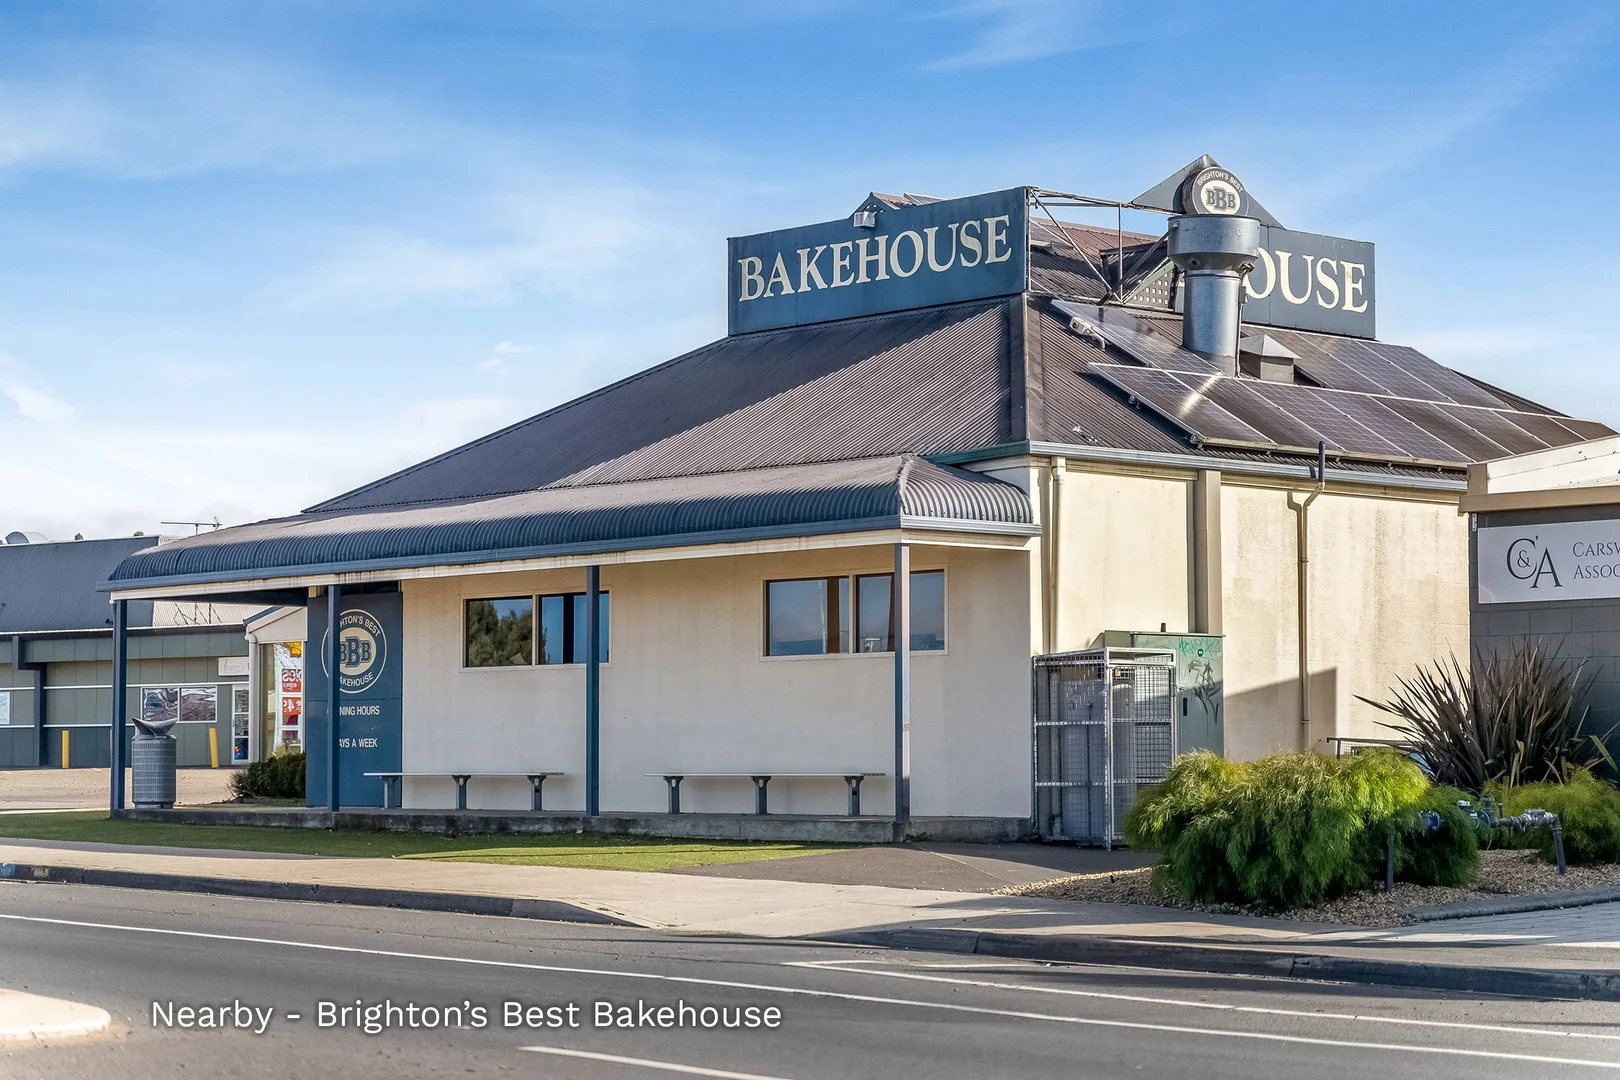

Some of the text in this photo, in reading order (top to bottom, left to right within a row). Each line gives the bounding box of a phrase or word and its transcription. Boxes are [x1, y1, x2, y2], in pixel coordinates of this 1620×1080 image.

[1196, 170, 1244, 192] BRIGHTON'S BEST
[1205, 186, 1237, 211] BBB
[738, 214, 1012, 302] BAKEHOUSE
[1244, 246, 1368, 313] OUSE
[340, 615, 381, 637] HTON'S BEST
[339, 671, 374, 687] AKEHOUSE
[339, 705, 380, 716] NING HOURS
[339, 738, 378, 748] AYS A WEEK
